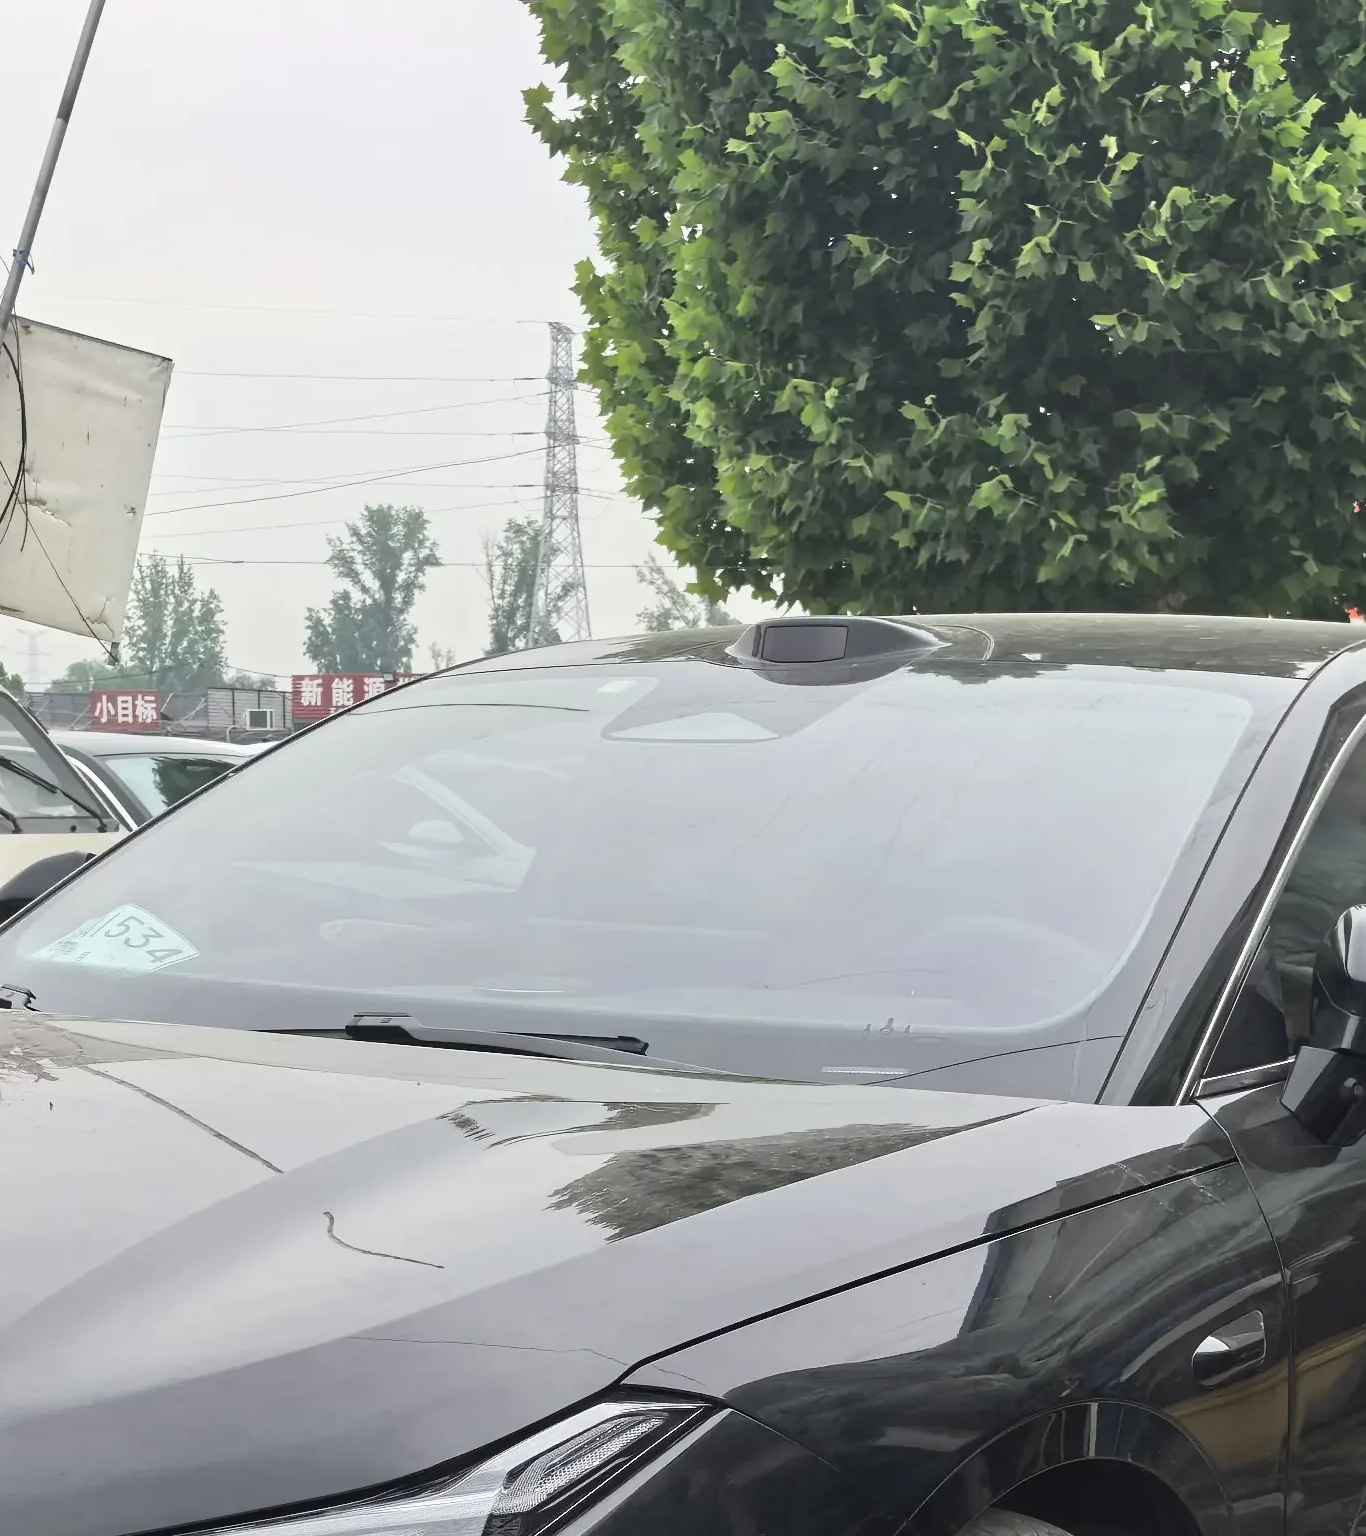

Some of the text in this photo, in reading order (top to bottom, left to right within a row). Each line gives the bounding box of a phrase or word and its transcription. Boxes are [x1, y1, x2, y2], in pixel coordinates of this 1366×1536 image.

[299, 677, 423, 706] 新能源
[94, 694, 158, 724] 小目标
